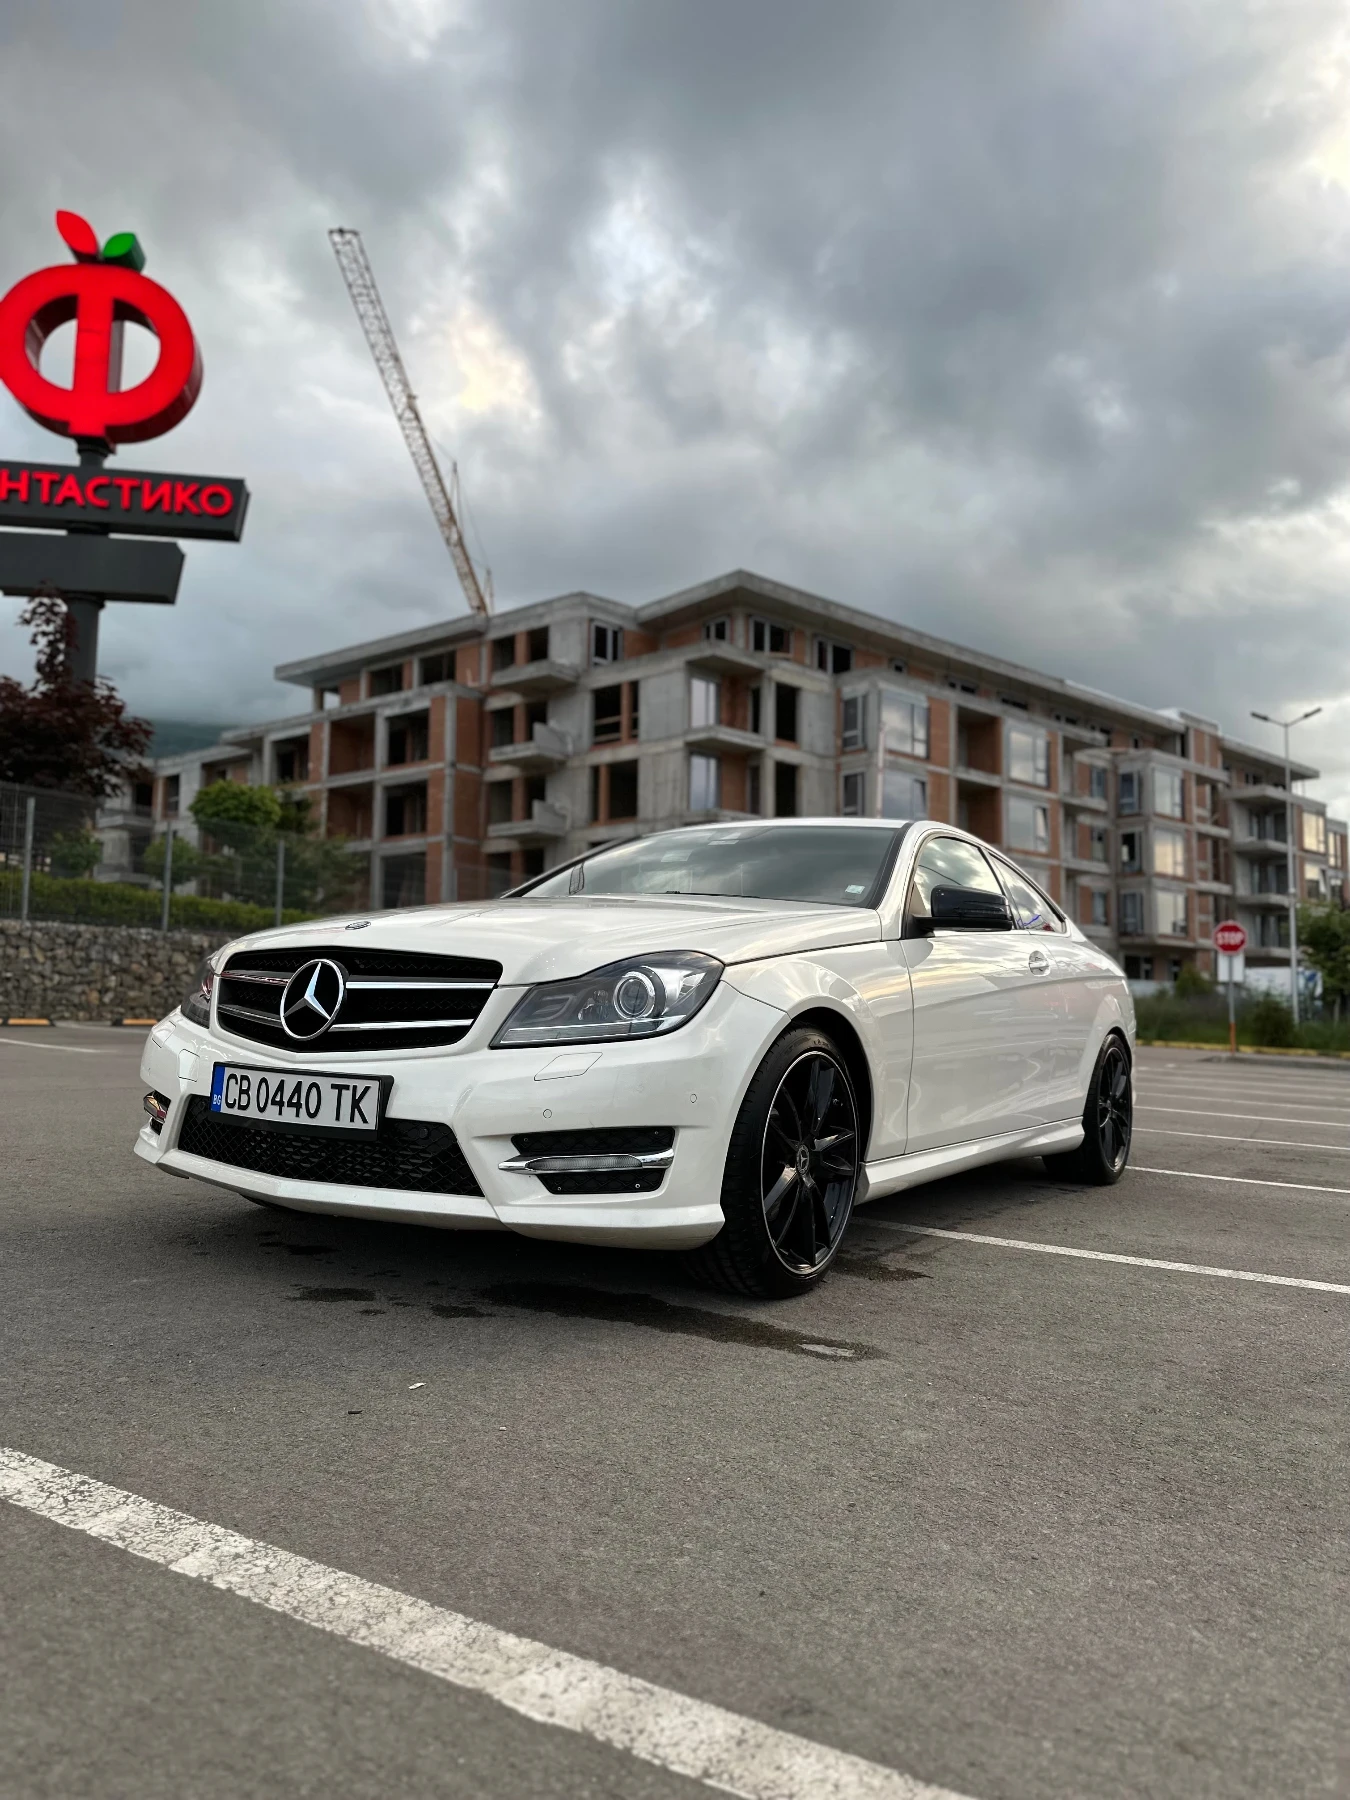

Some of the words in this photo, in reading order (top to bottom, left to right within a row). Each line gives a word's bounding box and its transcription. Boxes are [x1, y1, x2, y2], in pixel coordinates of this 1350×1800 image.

[0, 470, 232, 515] НТАСТИКО
[1217, 932, 1244, 946] STOP
[213, 1095, 221, 1105] BG
[225, 1074, 251, 1110] CB
[257, 1077, 321, 1118] 0440
[332, 1084, 372, 1123] TK
